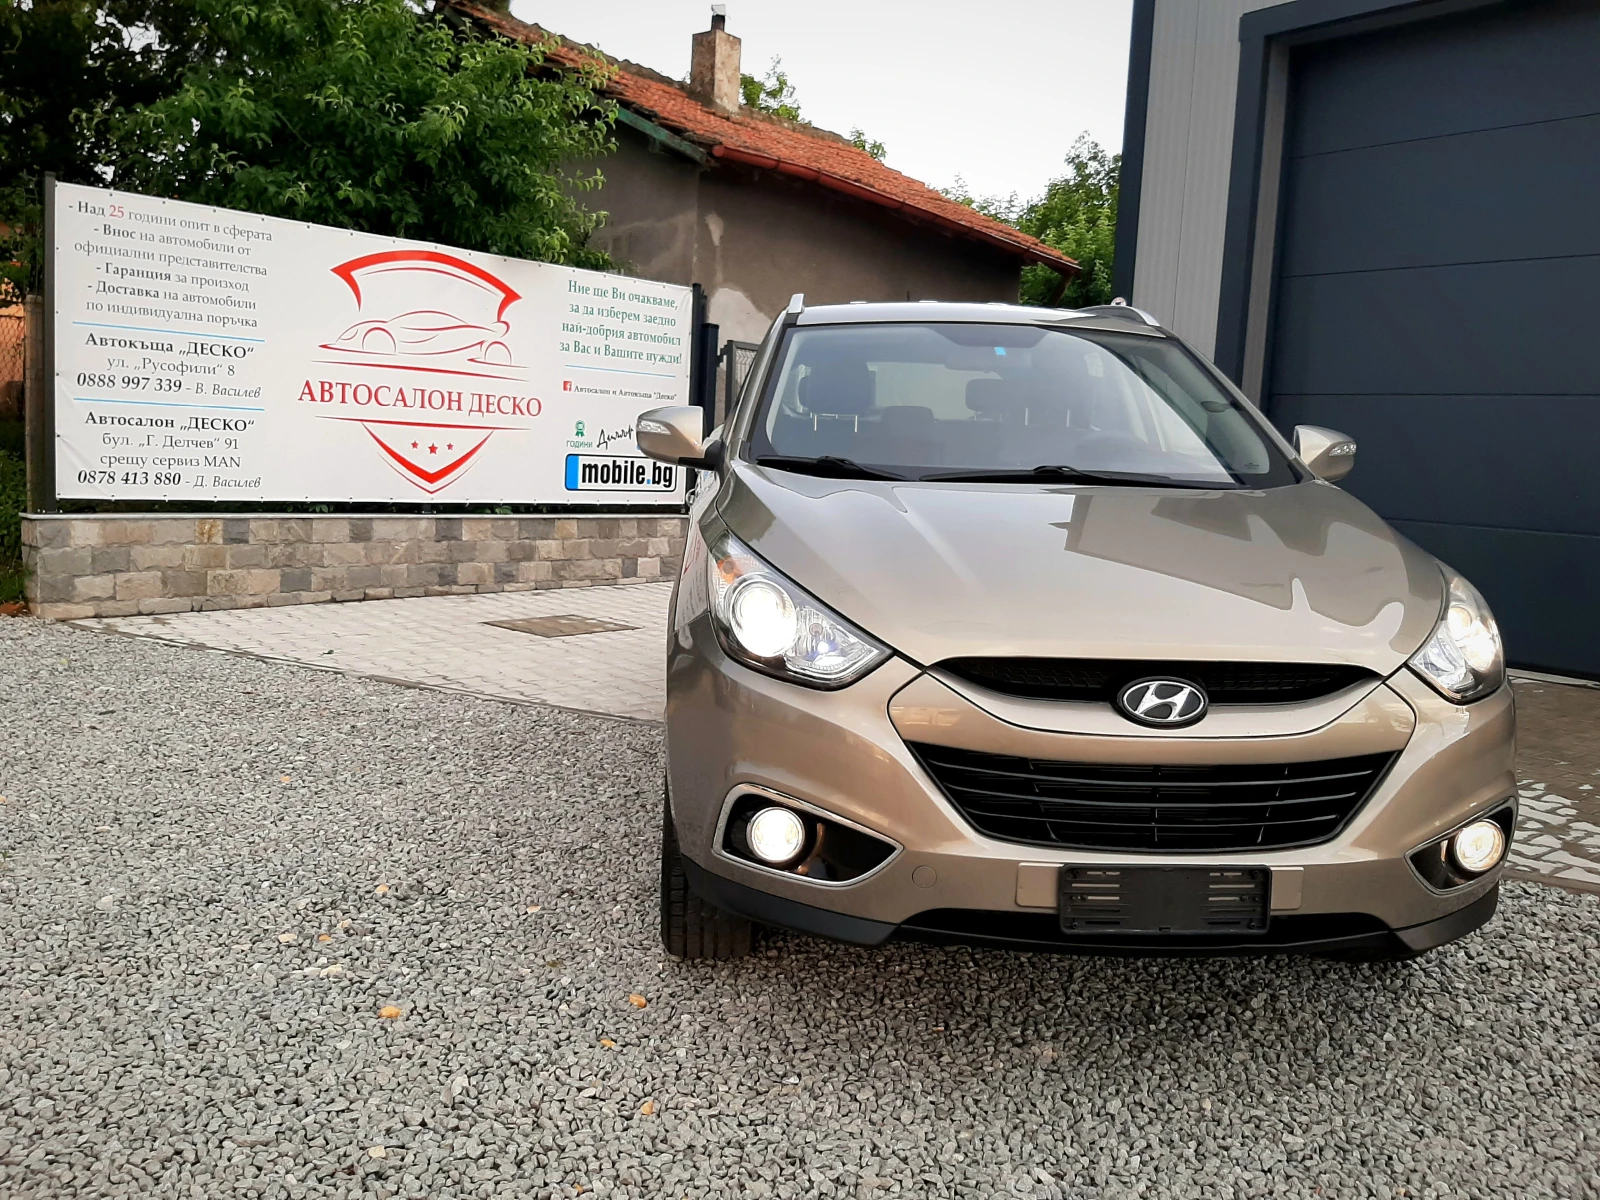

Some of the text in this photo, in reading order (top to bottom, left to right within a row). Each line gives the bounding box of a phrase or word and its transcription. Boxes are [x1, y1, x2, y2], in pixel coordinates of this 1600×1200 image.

[78, 201, 106, 216] Над
[109, 205, 125, 219] 25
[128, 212, 176, 227] години
[180, 220, 210, 232] опит
[214, 225, 221, 233] в
[223, 225, 273, 241] сферата
[103, 224, 137, 239] Внос
[140, 232, 155, 242] на
[159, 236, 234, 254] автомобили
[238, 247, 251, 256] от
[74, 240, 267, 276] официални представителства
[105, 263, 171, 282] Гаранция
[175, 274, 187, 283] за
[191, 276, 249, 292] произход
[96, 281, 159, 298] Доставка
[163, 291, 179, 301] на
[182, 293, 256, 310] автомобили
[568, 280, 678, 310] Ние ще Ви очакваме,
[86, 302, 258, 328] по индивидуална поръчка
[569, 304, 676, 327] за да изберем заедно
[85, 333, 173, 352] Автокъща
[562, 322, 681, 346] най-добрия автомобил
[560, 341, 682, 365] за Вас и Вашите нужди!
[107, 358, 129, 371] ул.
[227, 365, 235, 376] 8
[77, 373, 116, 388] 0888
[121, 376, 149, 390] 997
[154, 378, 182, 392] 339
[196, 382, 207, 395] В.
[212, 384, 261, 398] Василев
[298, 380, 543, 418] АВТОСАЛОН ДЕСКО
[85, 412, 175, 428] Автосалон
[103, 433, 133, 447] бул.
[224, 438, 238, 449] 91
[100, 455, 148, 468] срещу
[153, 455, 200, 468] сервиз
[582, 460, 673, 488] mobile.bg
[78, 470, 116, 484] 0878
[121, 472, 149, 485] 413
[154, 472, 181, 486] 880
[193, 476, 207, 488] Д.
[213, 476, 261, 488] Василев
